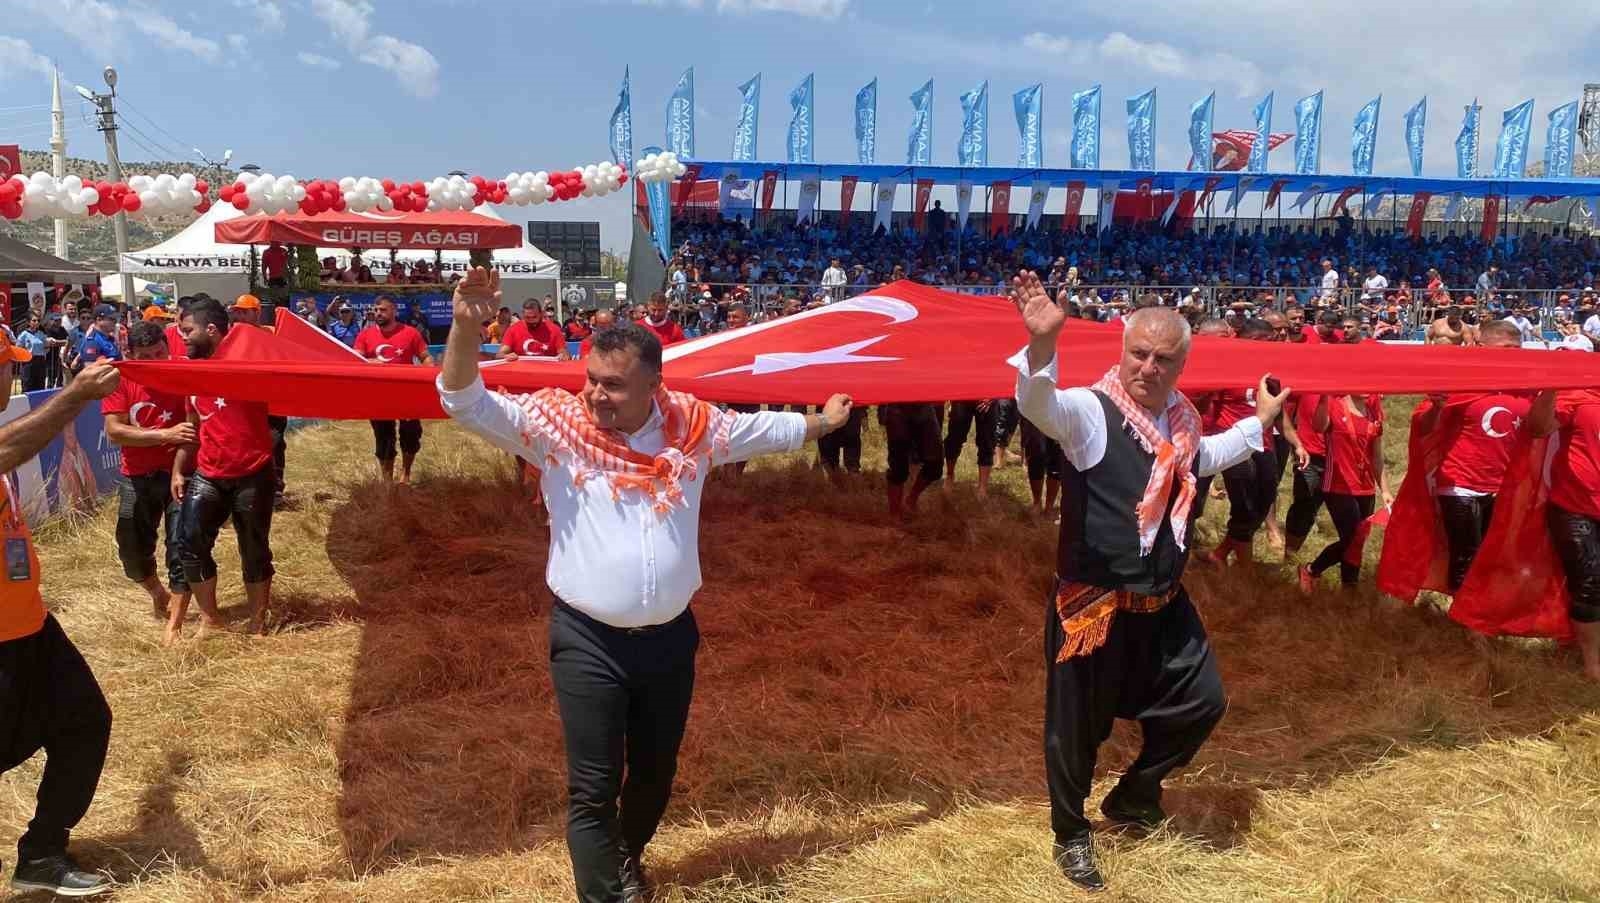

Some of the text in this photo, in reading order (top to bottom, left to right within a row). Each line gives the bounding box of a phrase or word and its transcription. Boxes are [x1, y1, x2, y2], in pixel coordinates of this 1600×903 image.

[322, 226, 479, 246] GÜREŞ AĞASI
[143, 257, 213, 267] ALANYA
